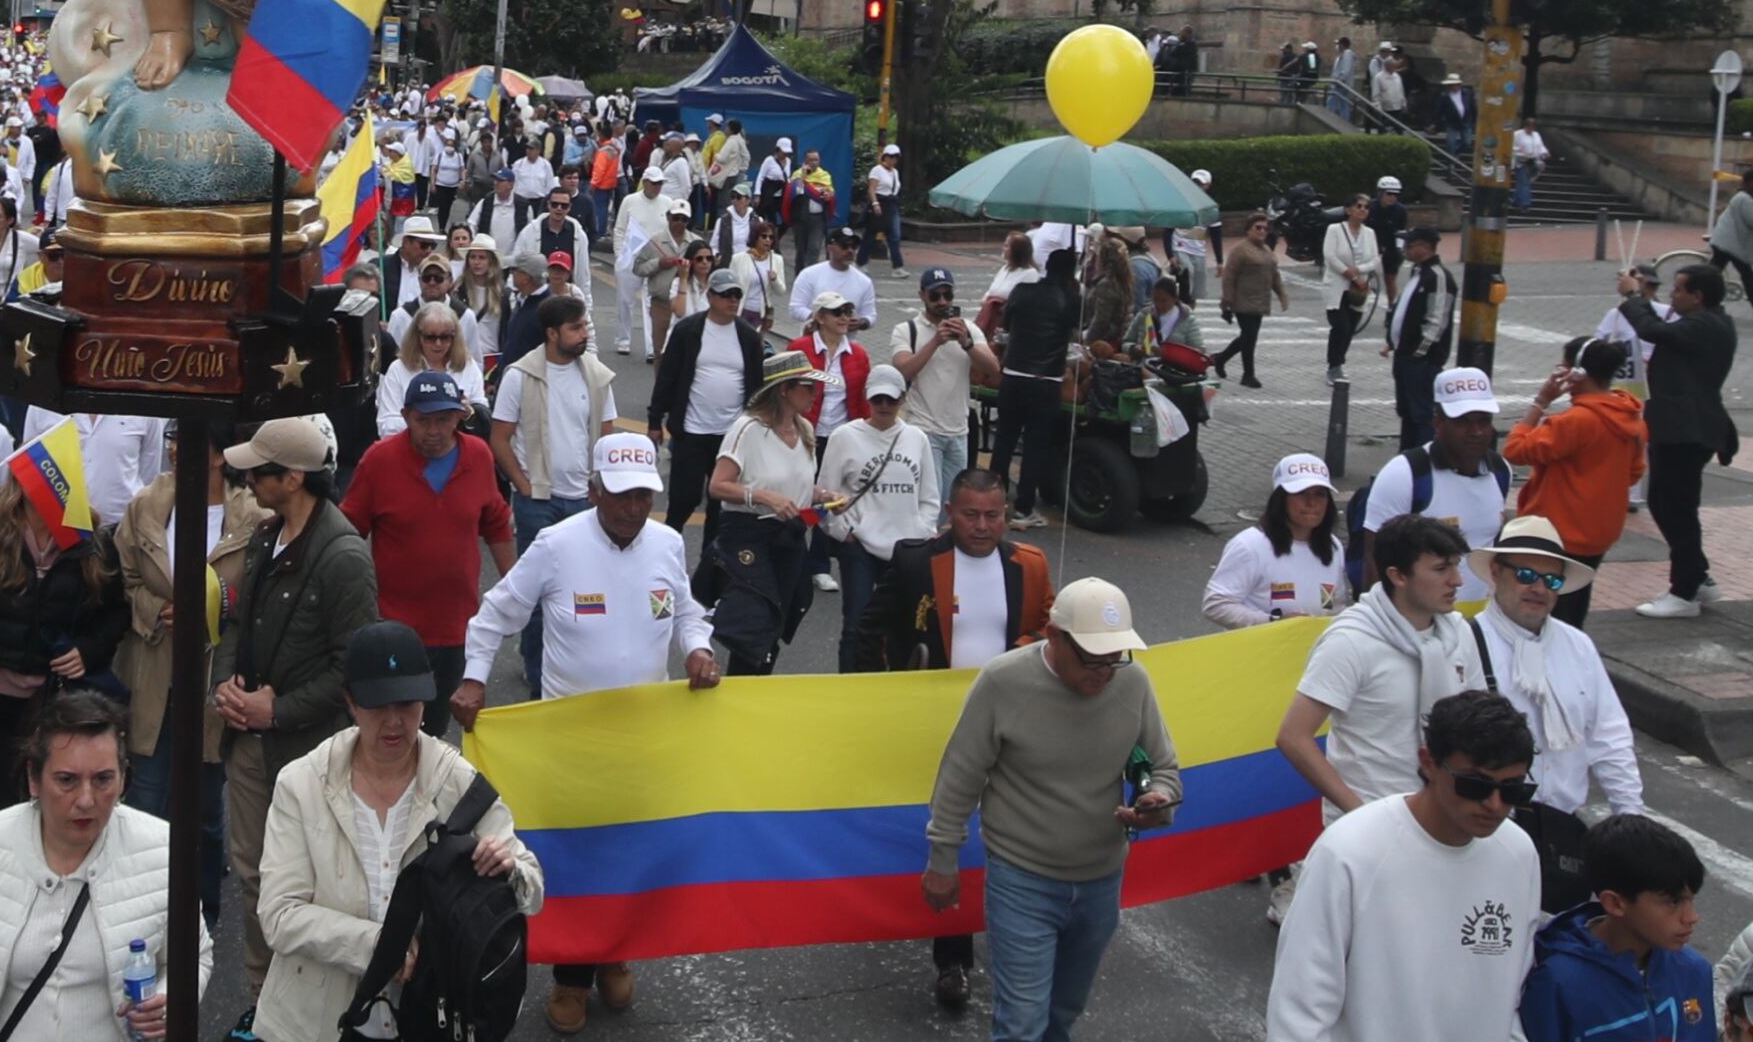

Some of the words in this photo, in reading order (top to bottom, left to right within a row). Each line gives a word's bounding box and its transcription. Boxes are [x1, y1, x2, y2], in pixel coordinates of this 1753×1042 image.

[107, 258, 233, 303] Divino
[1444, 379, 1487, 395] CREO
[608, 448, 654, 465] CREO
[1288, 462, 1328, 478] CREO
[881, 483, 915, 494] FITCH
